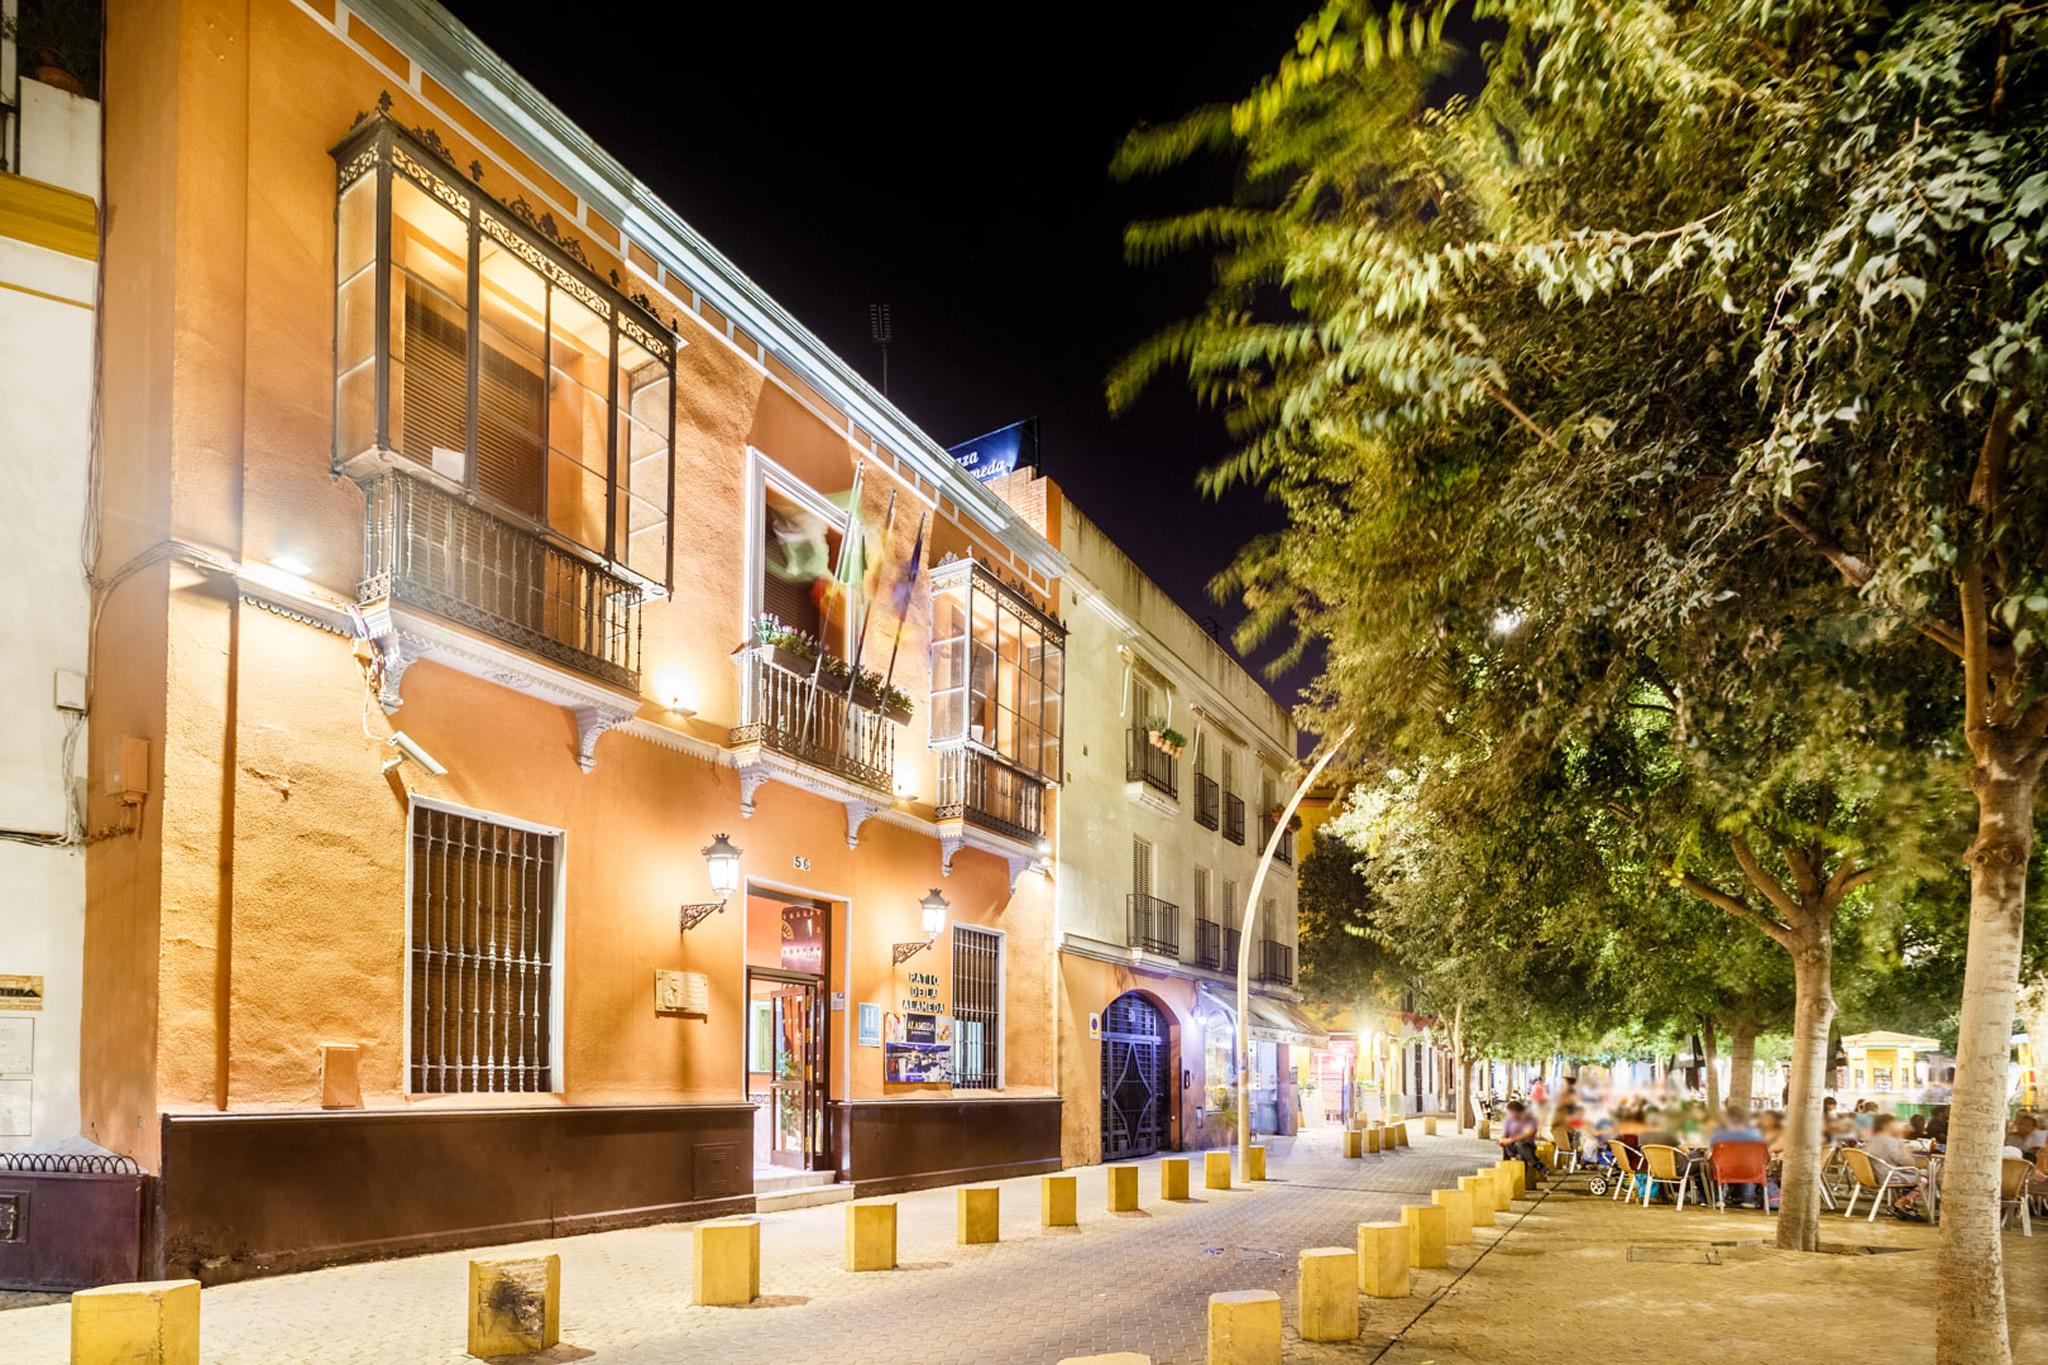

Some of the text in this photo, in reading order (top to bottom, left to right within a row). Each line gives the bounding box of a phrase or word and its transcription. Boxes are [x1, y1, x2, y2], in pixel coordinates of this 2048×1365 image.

[794, 855, 810, 870] 56
[909, 972, 939, 985] PATIO
[903, 1000, 944, 1013] ALAMEDA
